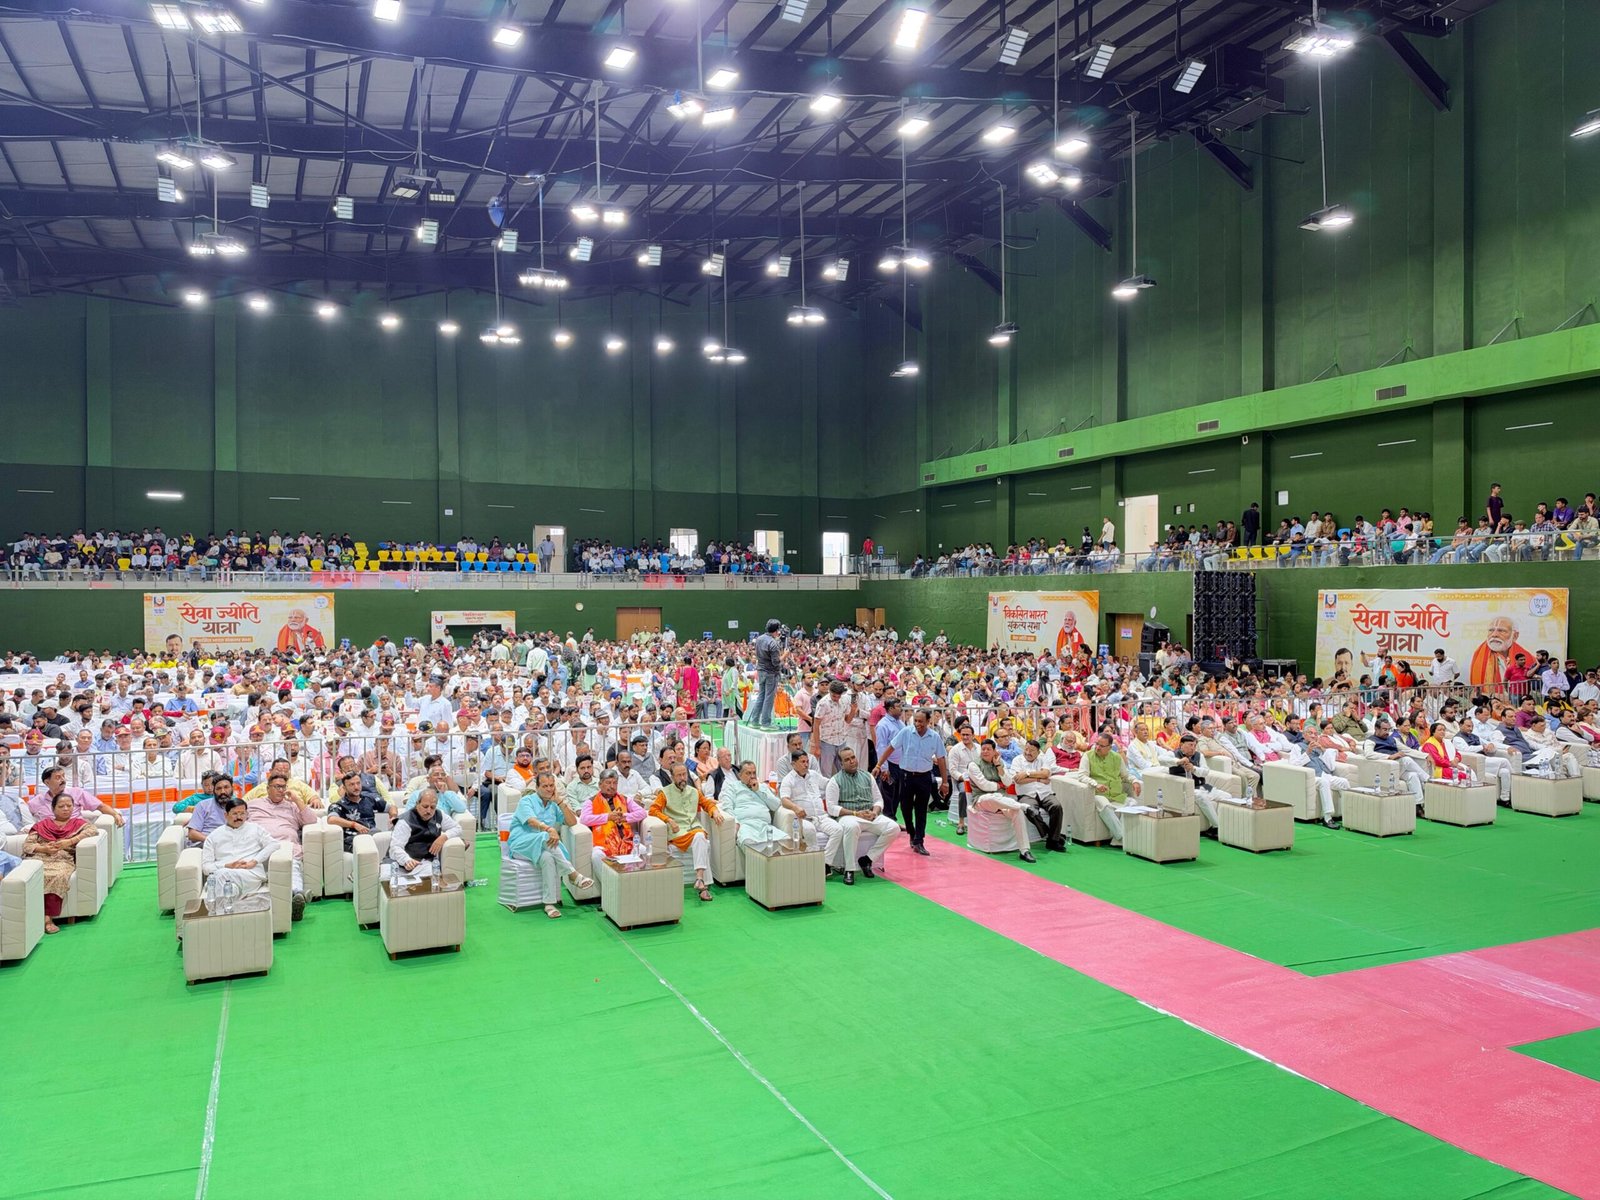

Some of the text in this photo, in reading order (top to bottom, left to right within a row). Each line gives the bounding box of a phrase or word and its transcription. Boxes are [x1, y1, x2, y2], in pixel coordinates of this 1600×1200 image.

[177, 602, 261, 624] सेवा ज्योति
[1003, 605, 1048, 624] विकसित भारत
[1349, 603, 1450, 638] सेवा ज्योति
[202, 621, 241, 635] यात्रा
[1007, 620, 1041, 633] संकल्प सभा
[1376, 632, 1424, 653] यात्रा
